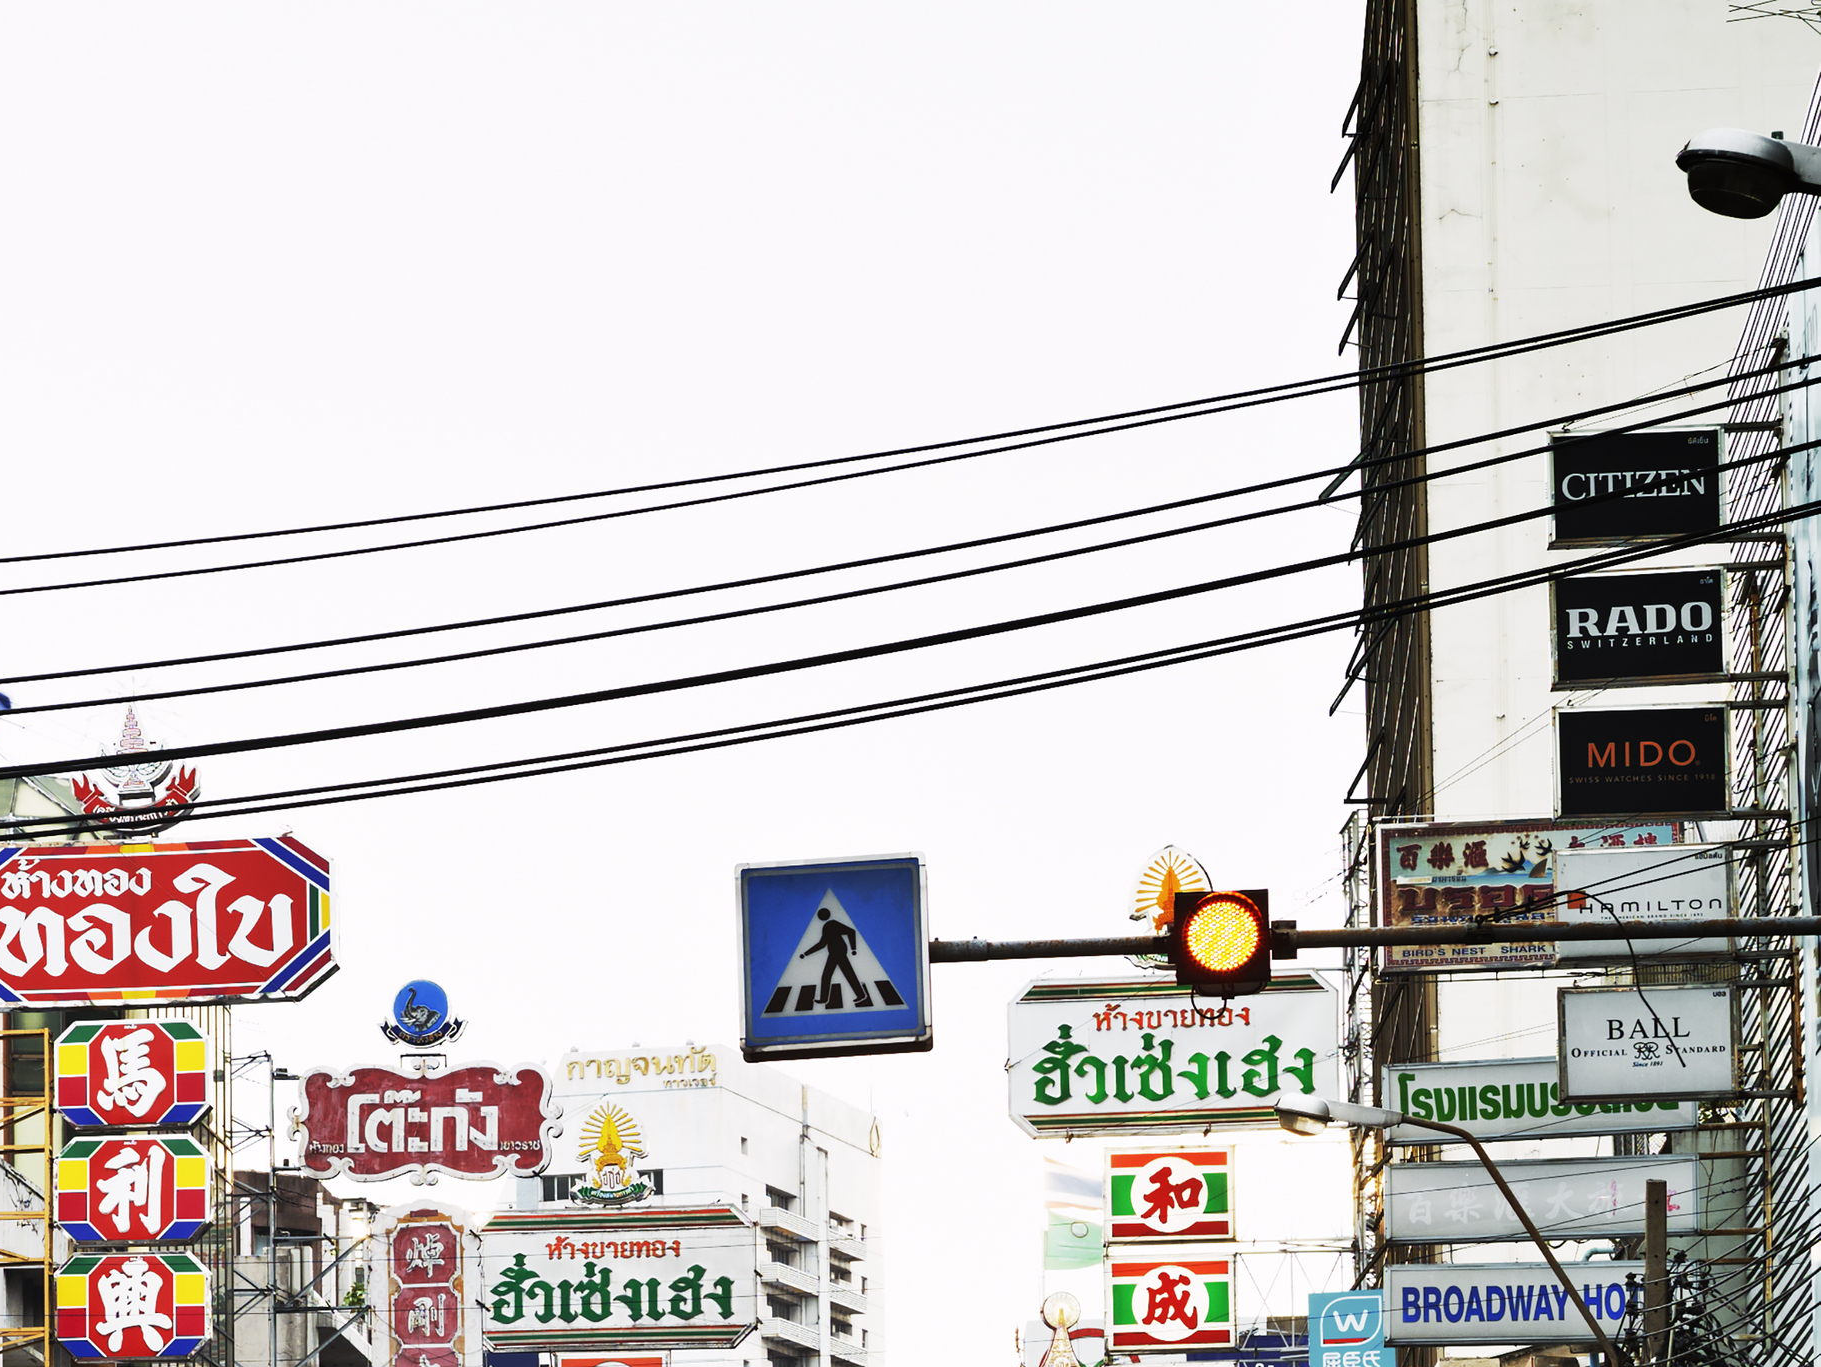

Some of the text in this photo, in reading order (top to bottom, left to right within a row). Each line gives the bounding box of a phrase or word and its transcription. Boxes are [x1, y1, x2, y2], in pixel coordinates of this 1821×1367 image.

[1561, 468, 1706, 501] CITIZEN
[1565, 601, 1713, 638] RADO
[1566, 632, 1714, 650] SWITZERLAND
[1587, 739, 1696, 768] MIDO
[1569, 776, 1600, 784] SWISS
[1605, 774, 1653, 783] WATCHES
[1657, 773, 1689, 782] SINCE
[0, 858, 152, 899] ห้างทอง
[1579, 898, 1722, 914] HAMILTON
[1401, 944, 1547, 958] BIRD'S NEST SHARK
[1606, 1016, 1691, 1041] BALL
[347, 1088, 499, 1154] โต๊ะกัง
[1401, 1284, 1569, 1324] BROADWAY
